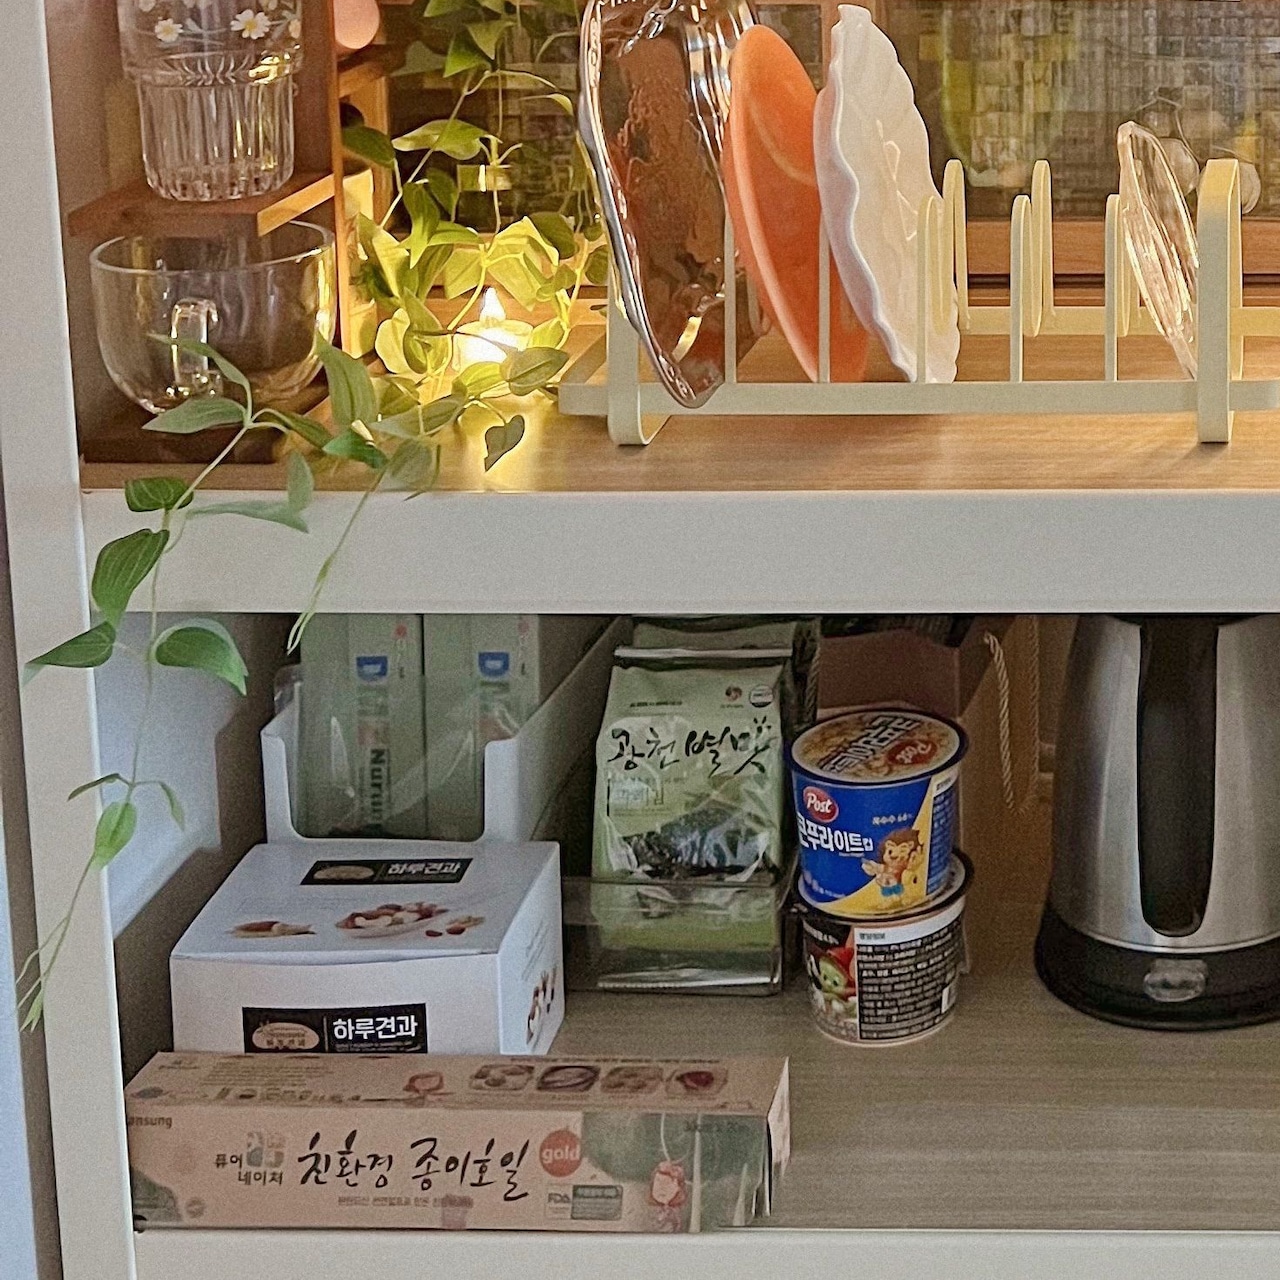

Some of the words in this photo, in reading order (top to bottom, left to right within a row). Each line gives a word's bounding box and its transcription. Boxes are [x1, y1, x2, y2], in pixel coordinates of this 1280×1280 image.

[895, 741, 932, 764] Post
[807, 794, 833, 814] Post
[388, 862, 461, 874] 하루견과
[333, 1015, 418, 1040] 하루견과
[215, 1154, 243, 1169] 퓨어
[542, 1143, 581, 1162] gold
[298, 1130, 393, 1188] 친환경
[411, 1137, 530, 1202] 종이호일
[238, 1171, 283, 1186] 네이처
